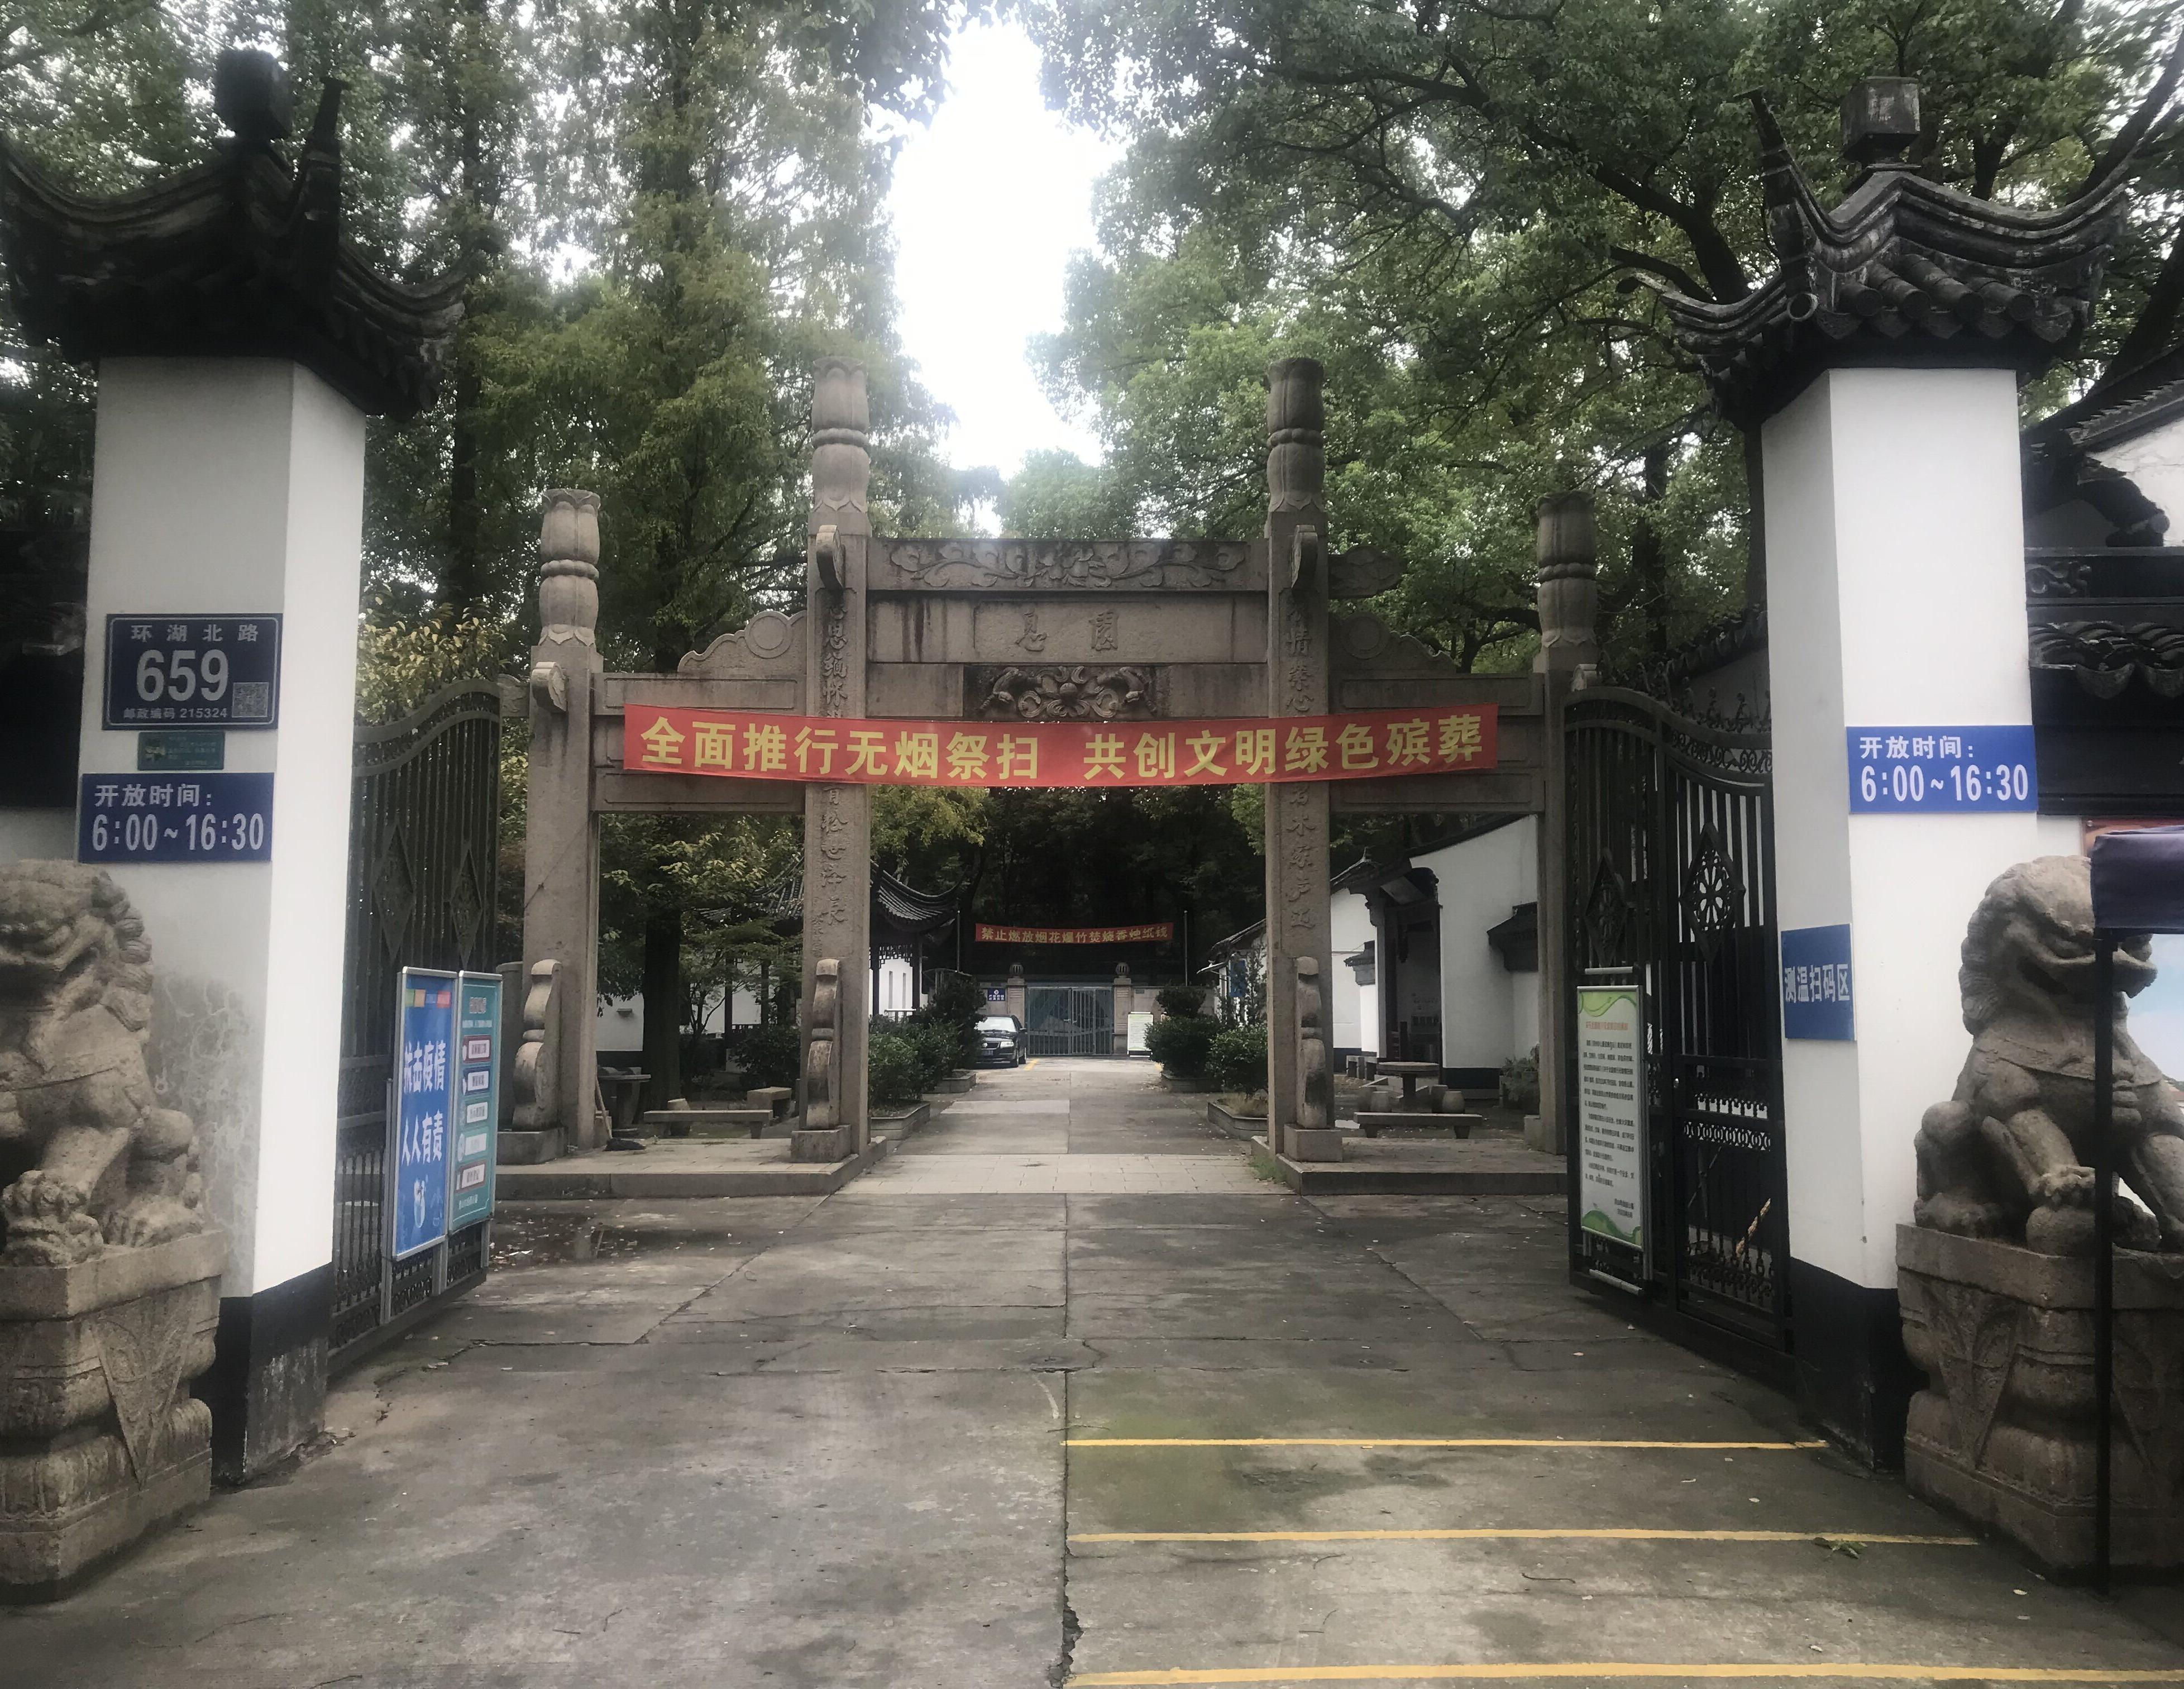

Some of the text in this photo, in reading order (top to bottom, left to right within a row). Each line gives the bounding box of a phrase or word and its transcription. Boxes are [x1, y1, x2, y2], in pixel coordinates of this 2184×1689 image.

[130, 623, 258, 642] 环湖北路
[136, 649, 229, 702] 659
[123, 708, 227, 719] 邮政编码 215324
[641, 714, 1483, 780] 全面推行无烟祭扫 共创文明绿色殡葬
[1861, 764, 2028, 801] 6:00~16:30
[92, 813, 264, 851] 6:00~16:30
[1784, 963, 1851, 1004] 测温扫码区
[403, 1039, 446, 1095] 抗击疫情
[401, 1109, 443, 1167] 人人有责
